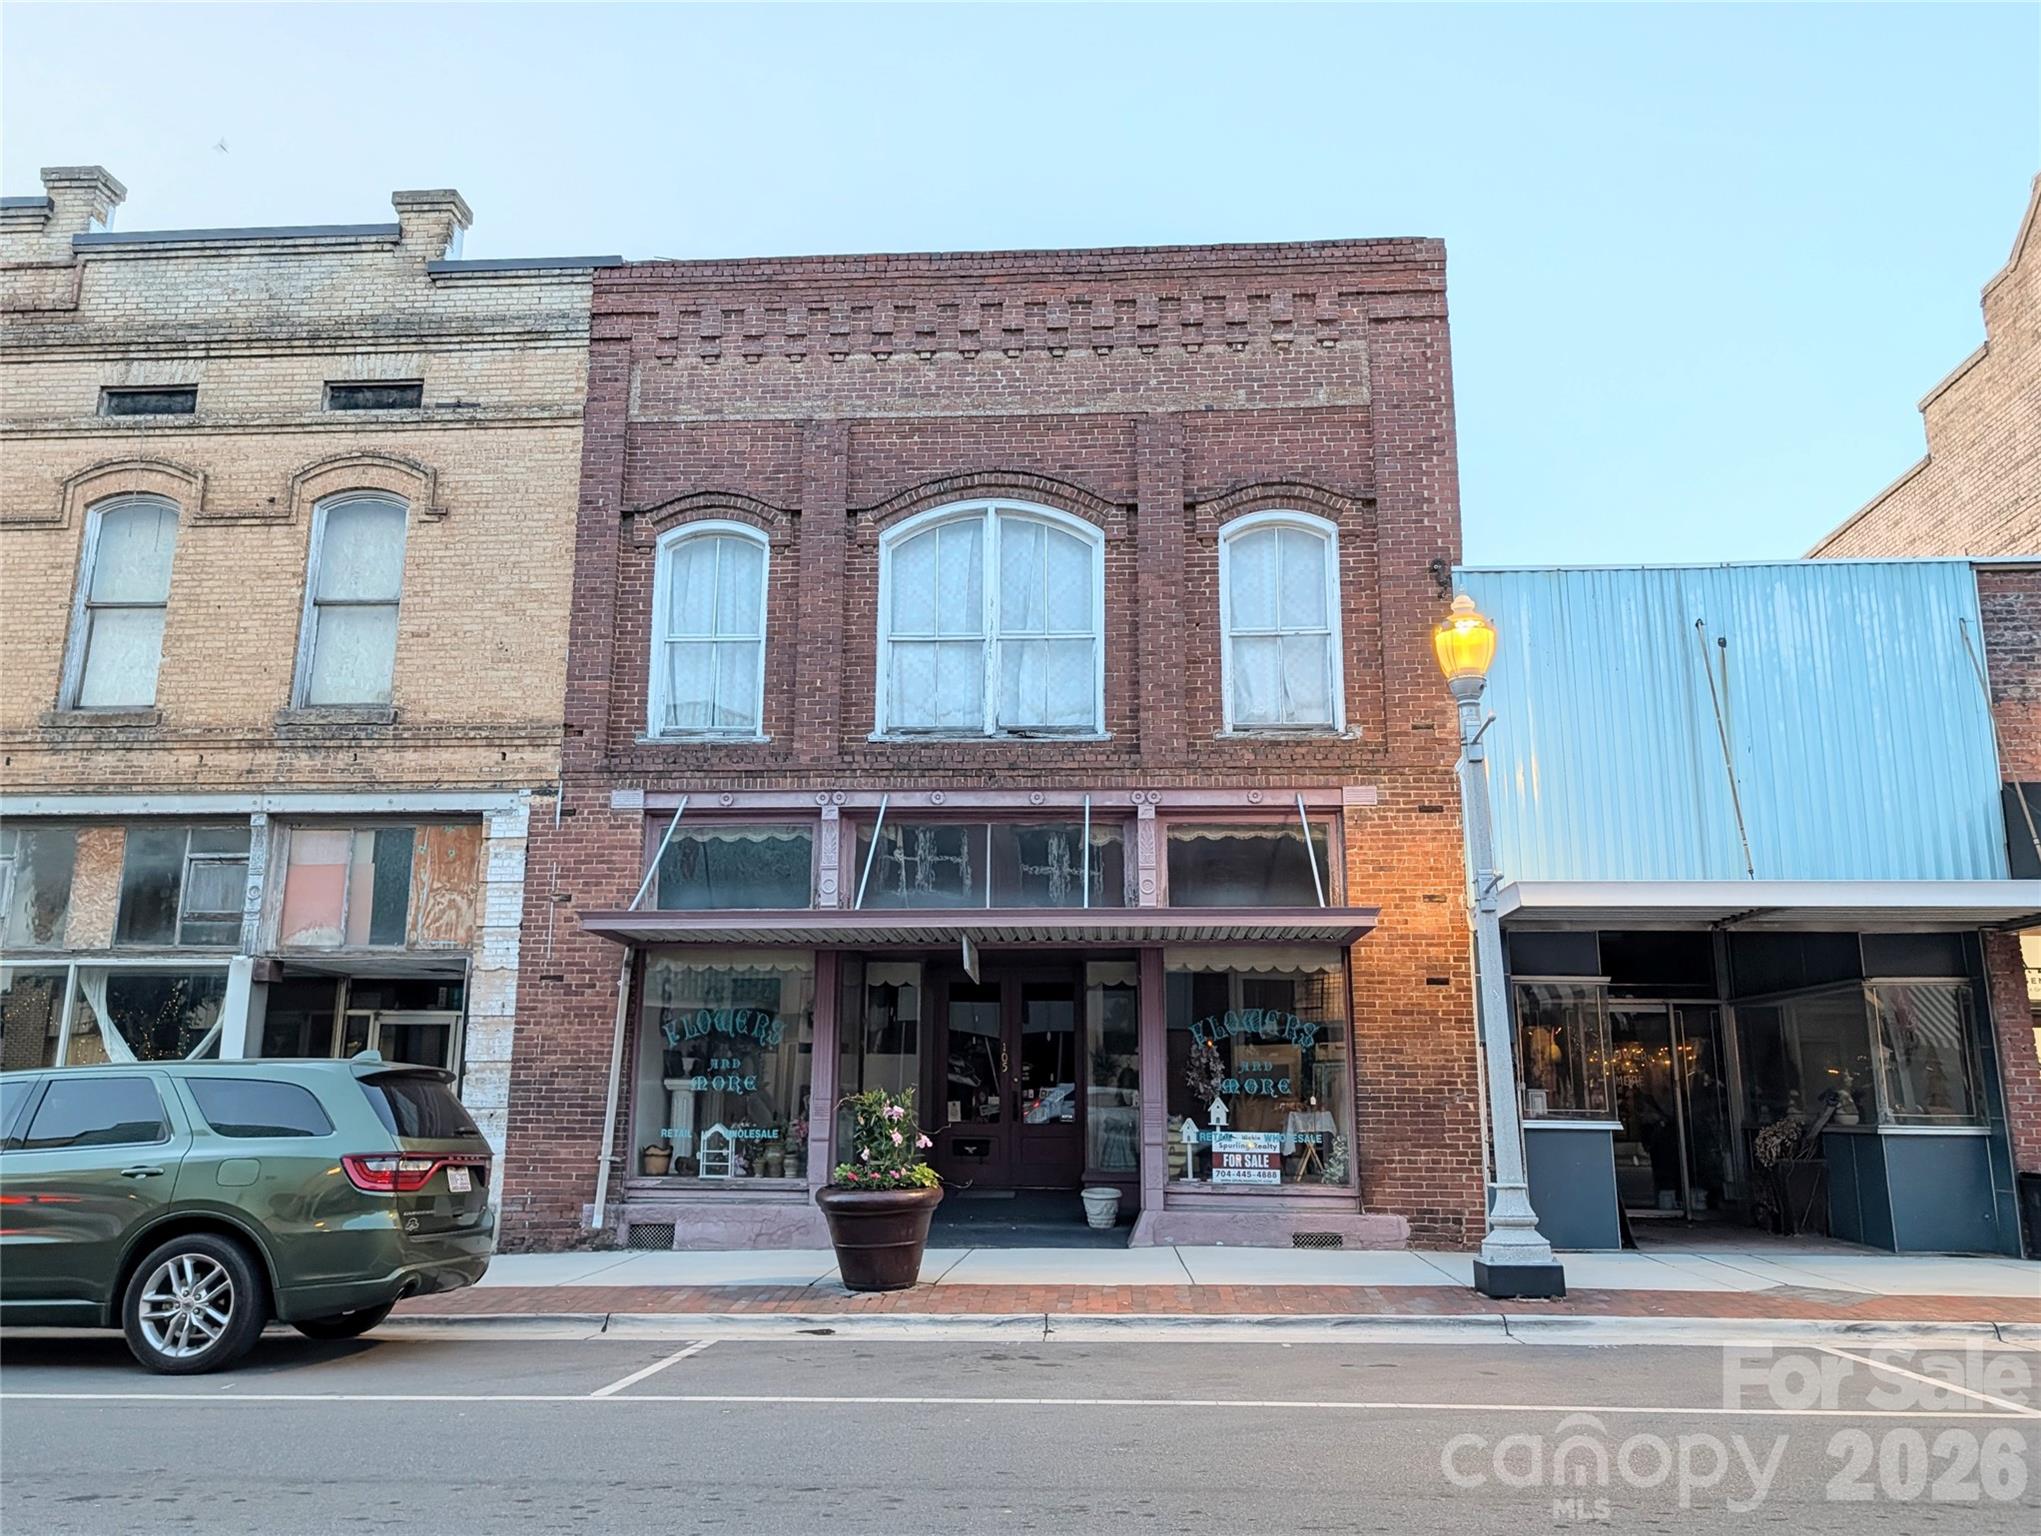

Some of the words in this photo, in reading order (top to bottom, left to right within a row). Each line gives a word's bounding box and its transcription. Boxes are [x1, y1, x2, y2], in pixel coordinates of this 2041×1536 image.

[662, 1007, 788, 1049] FLOWERS
[1189, 1008, 1320, 1052] FLOWERS
[707, 1058, 741, 1071] AND
[1239, 1061, 1273, 1074] AND
[691, 1076, 758, 1095] MORE
[1221, 1079, 1292, 1098] MORE
[661, 1128, 693, 1138] RETAIL
[725, 1129, 780, 1139] WHOLESALE
[1223, 1154, 1242, 1168] FOR
[1244, 1154, 1270, 1168] SALE
